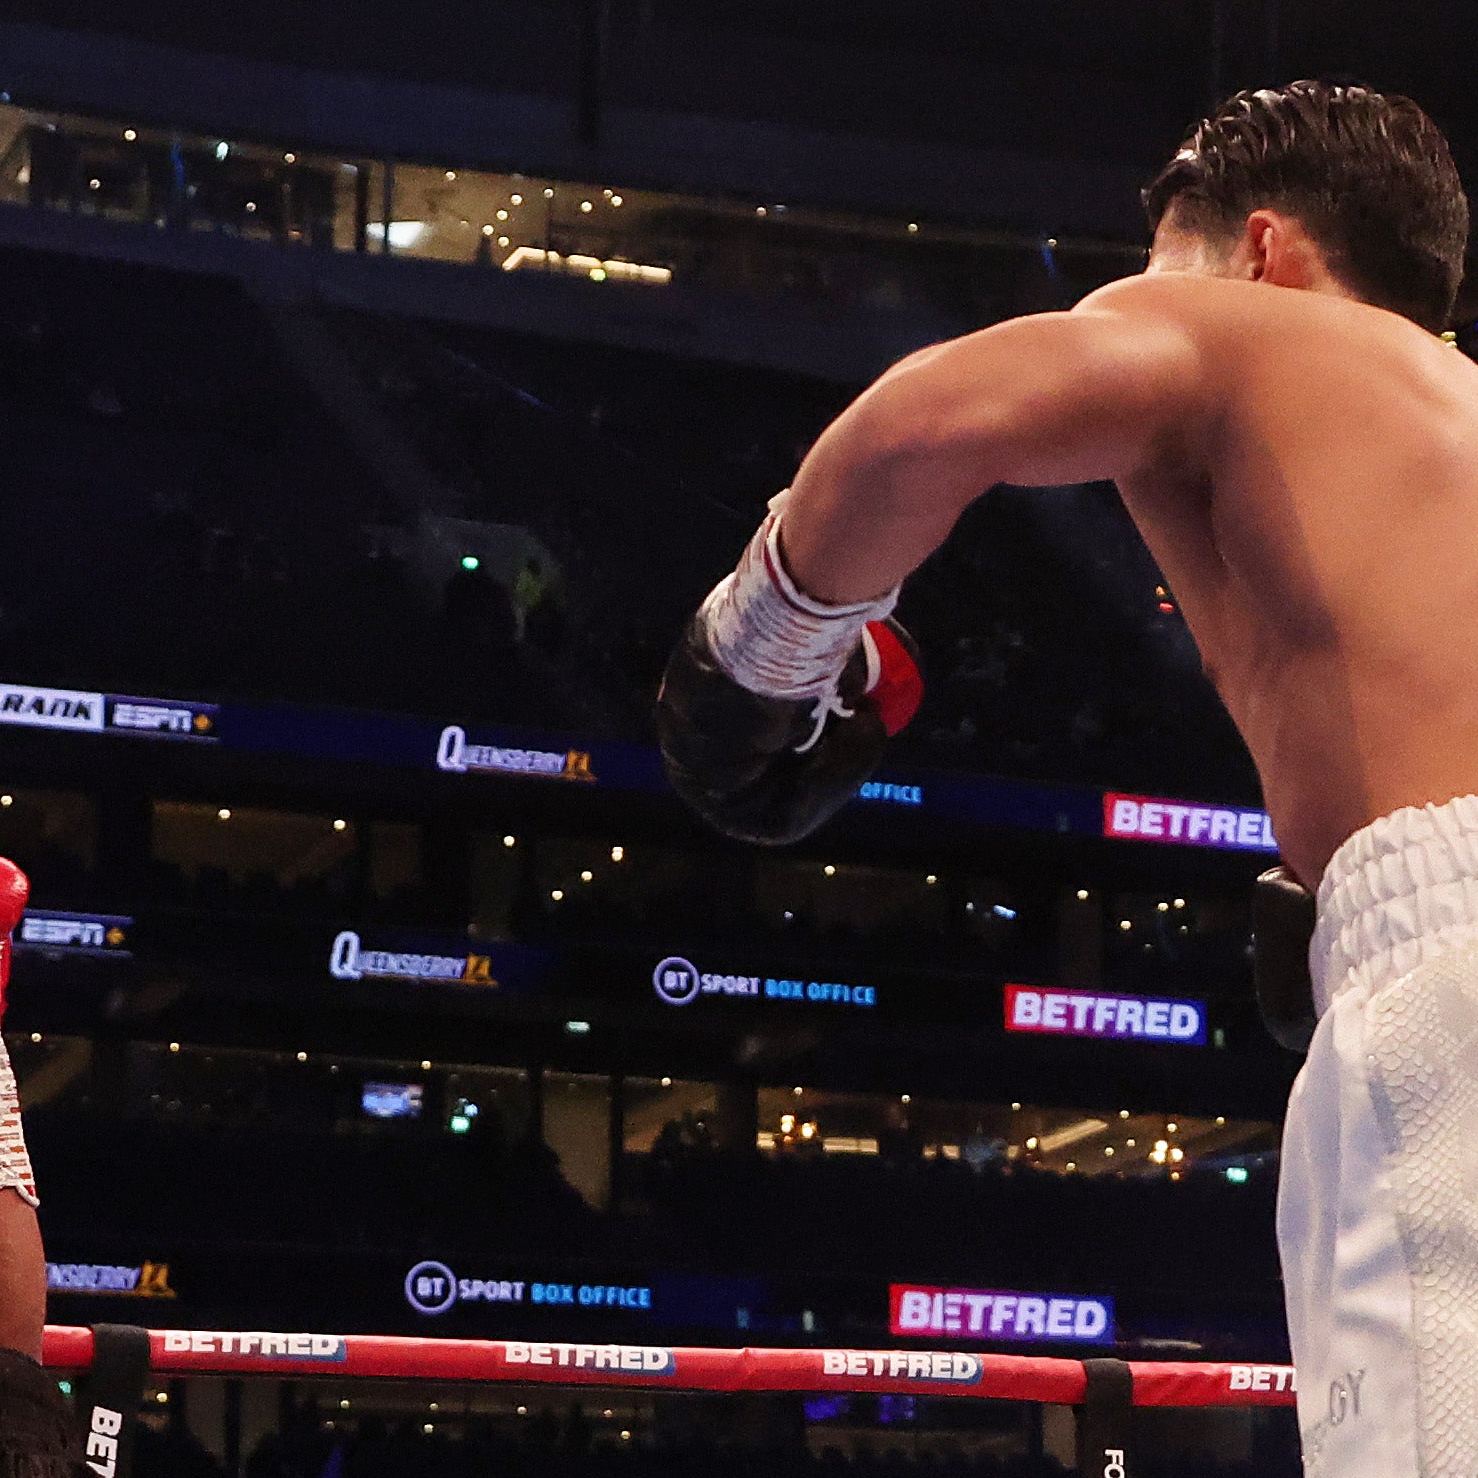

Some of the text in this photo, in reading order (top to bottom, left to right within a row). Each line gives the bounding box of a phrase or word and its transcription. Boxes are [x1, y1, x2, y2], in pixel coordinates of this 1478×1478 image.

[2, 694, 92, 722] RANK
[664, 971, 876, 1006] BT SPORT BOX OFFICE
[1014, 992, 1201, 1038] BETFRED
[417, 1276, 652, 1308] BT SPORT BOX OFFICE
[898, 1291, 1107, 1339] BETFRED
[164, 1330, 341, 1357] BETFRED
[503, 1344, 670, 1371] BETFRED
[822, 1353, 978, 1381] BETFRED
